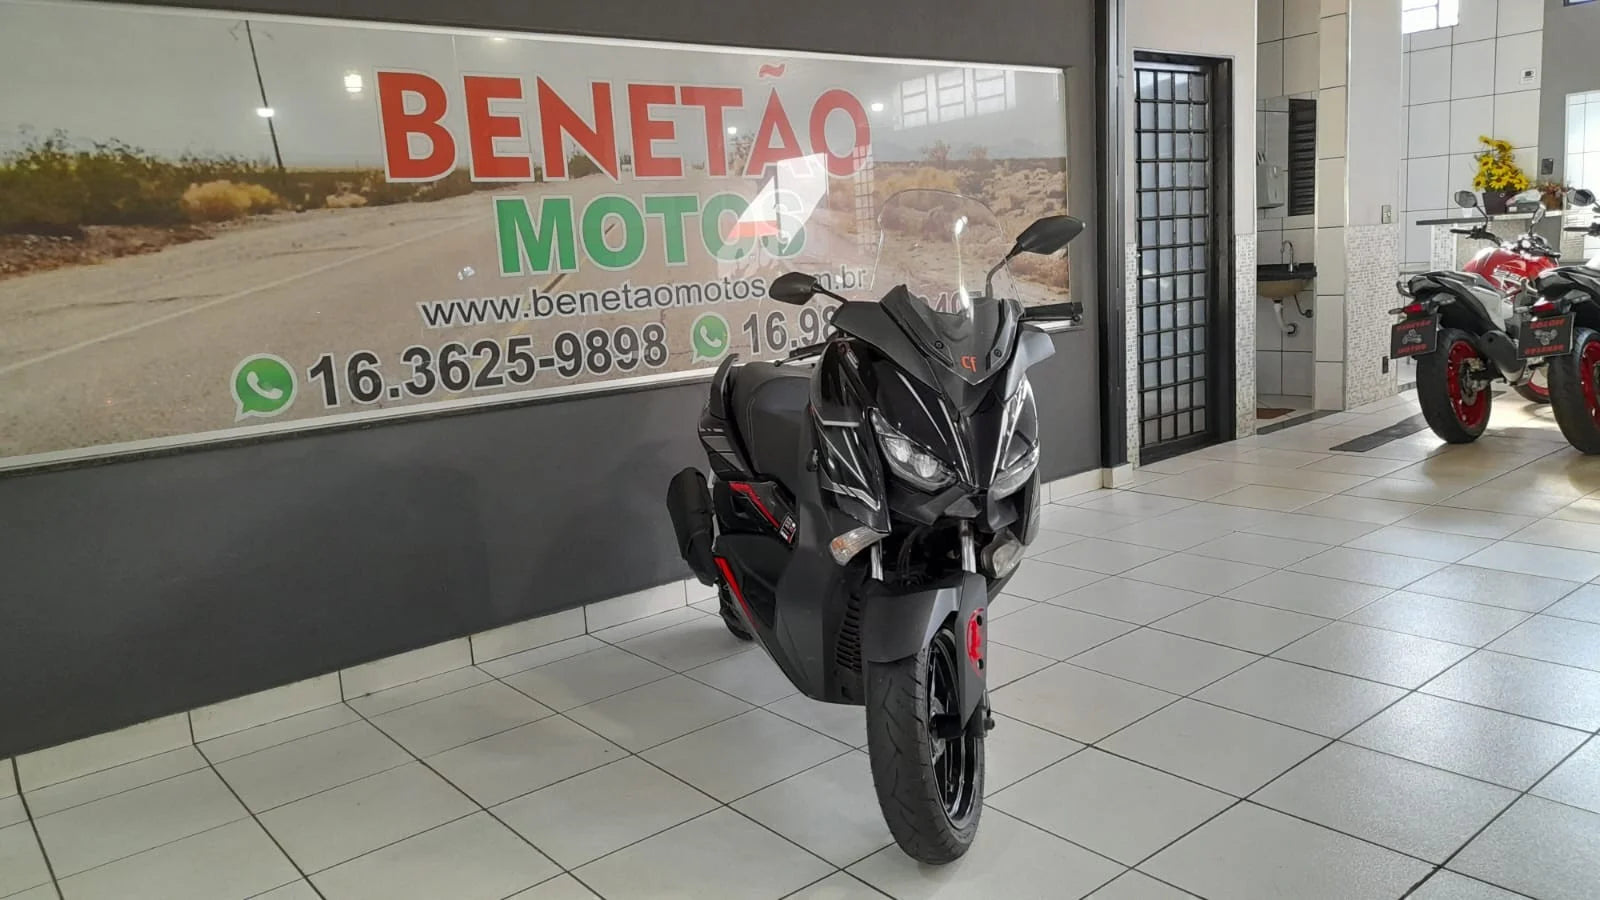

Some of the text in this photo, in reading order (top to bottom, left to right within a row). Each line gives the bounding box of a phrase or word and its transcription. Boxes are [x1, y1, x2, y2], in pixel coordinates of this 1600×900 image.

[376, 63, 872, 183] BENETÃO
[495, 190, 807, 275] MOTOS
[421, 266, 868, 327] www.benetaomotosm.br
[308, 323, 669, 407] 16.3625-9898
